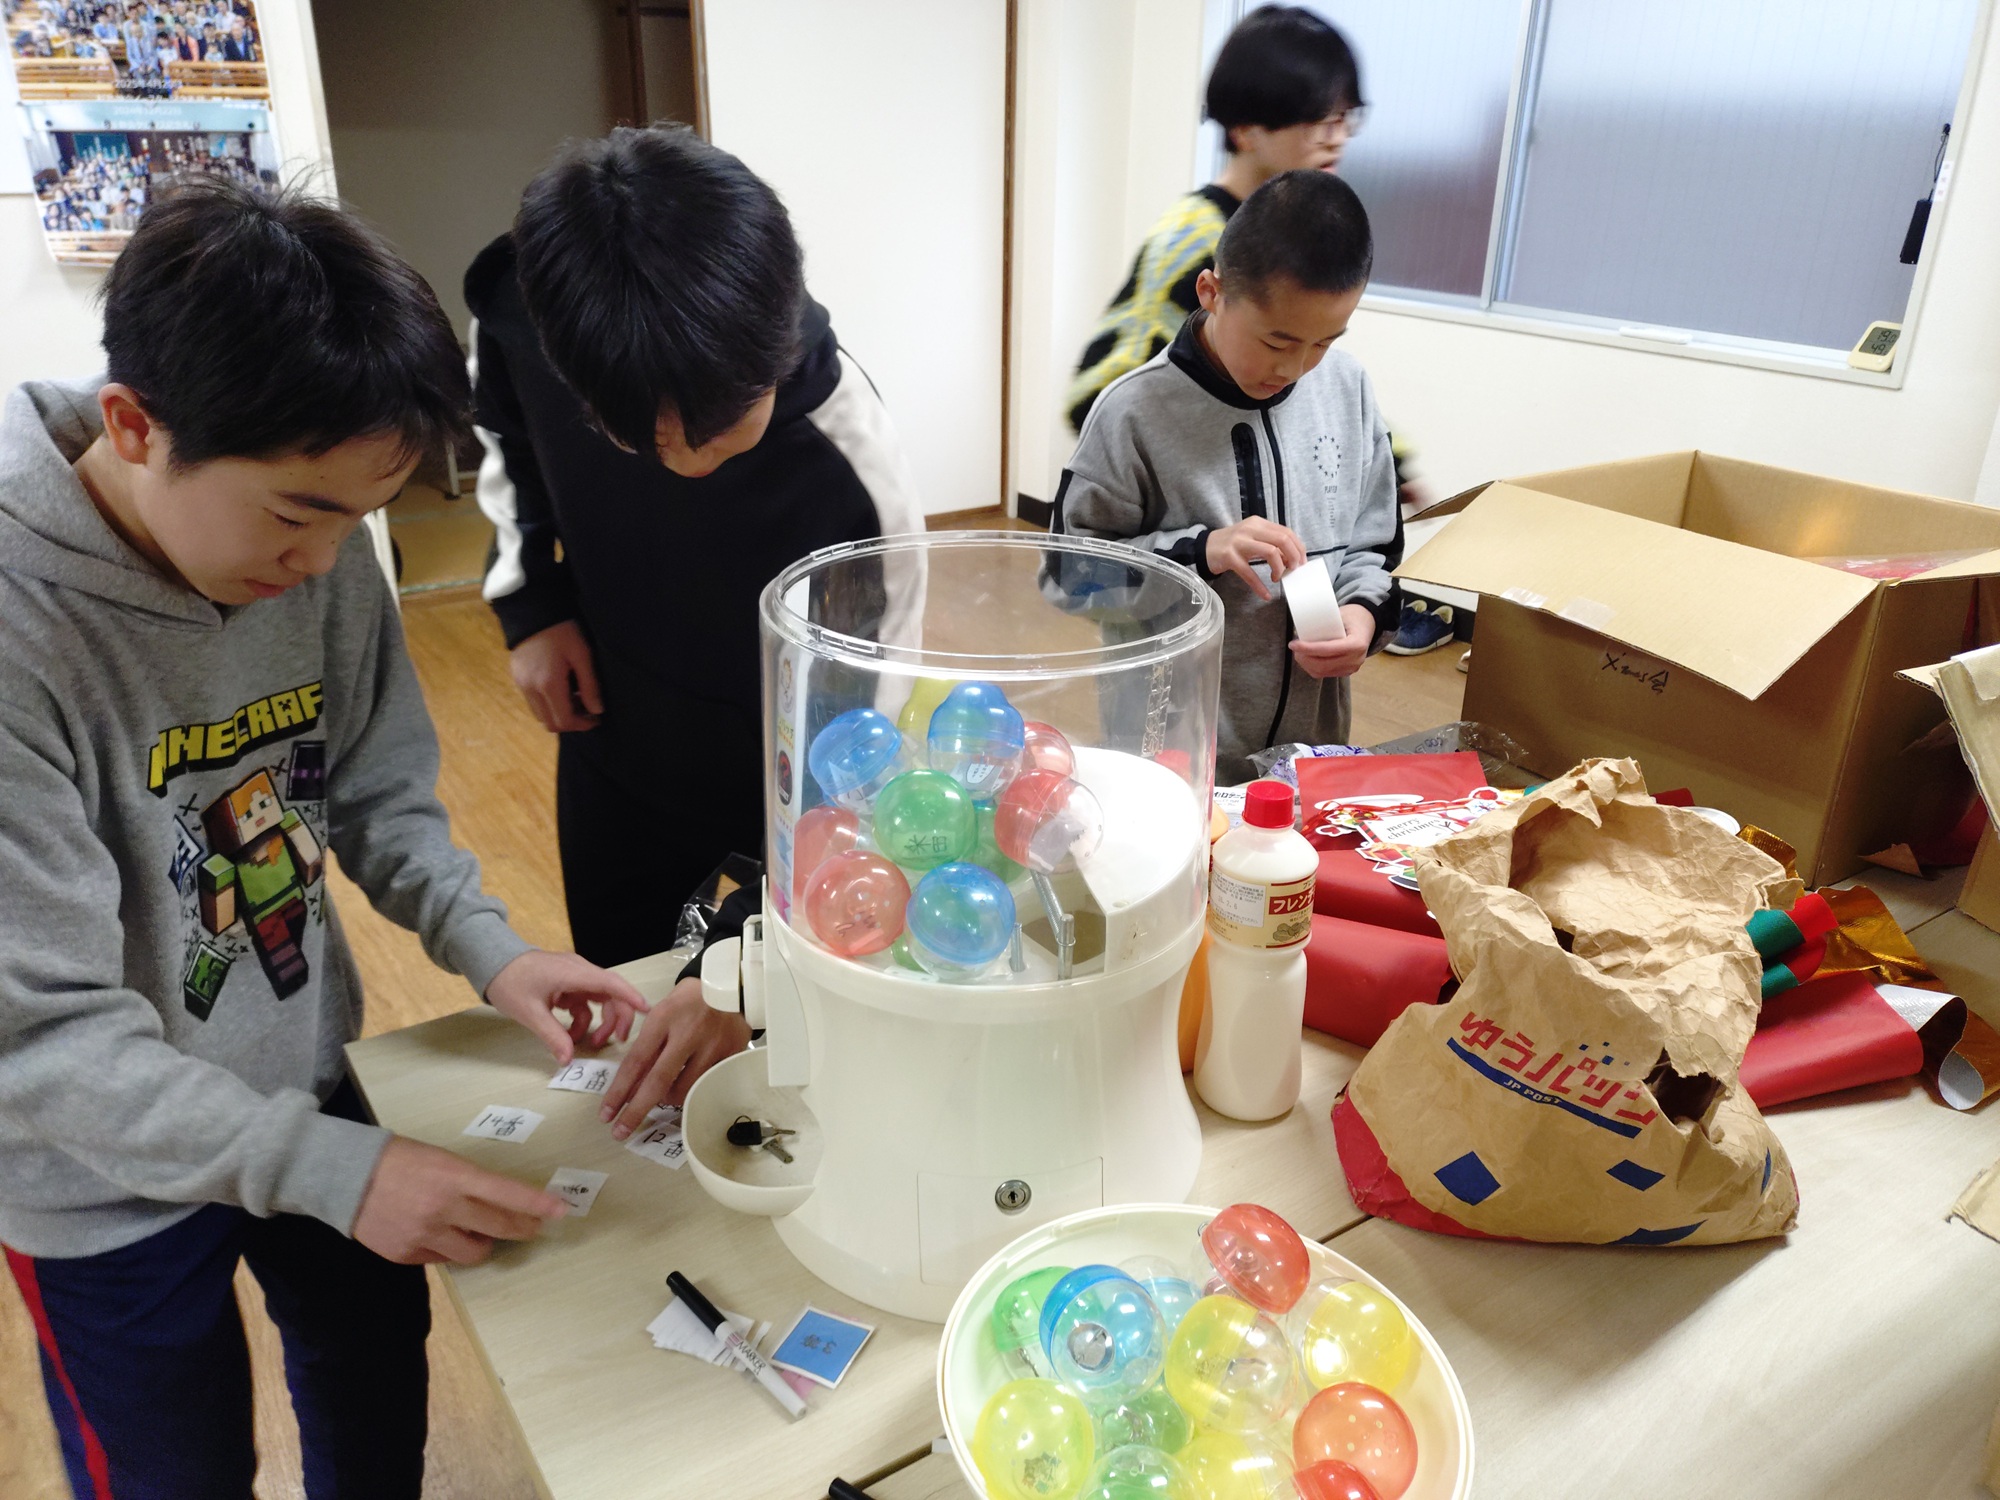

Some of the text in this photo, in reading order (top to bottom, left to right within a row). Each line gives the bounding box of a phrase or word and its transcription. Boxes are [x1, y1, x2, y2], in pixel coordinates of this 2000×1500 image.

[1386, 818, 1420, 833] merry
[1387, 819, 1440, 840] christmas
[559, 1065, 610, 1092] 13番
[1503, 1079, 1563, 1104] JP POST
[477, 1113, 524, 1137] 14番
[643, 1129, 685, 1159] 12番
[738, 1340, 766, 1370] MARKER
